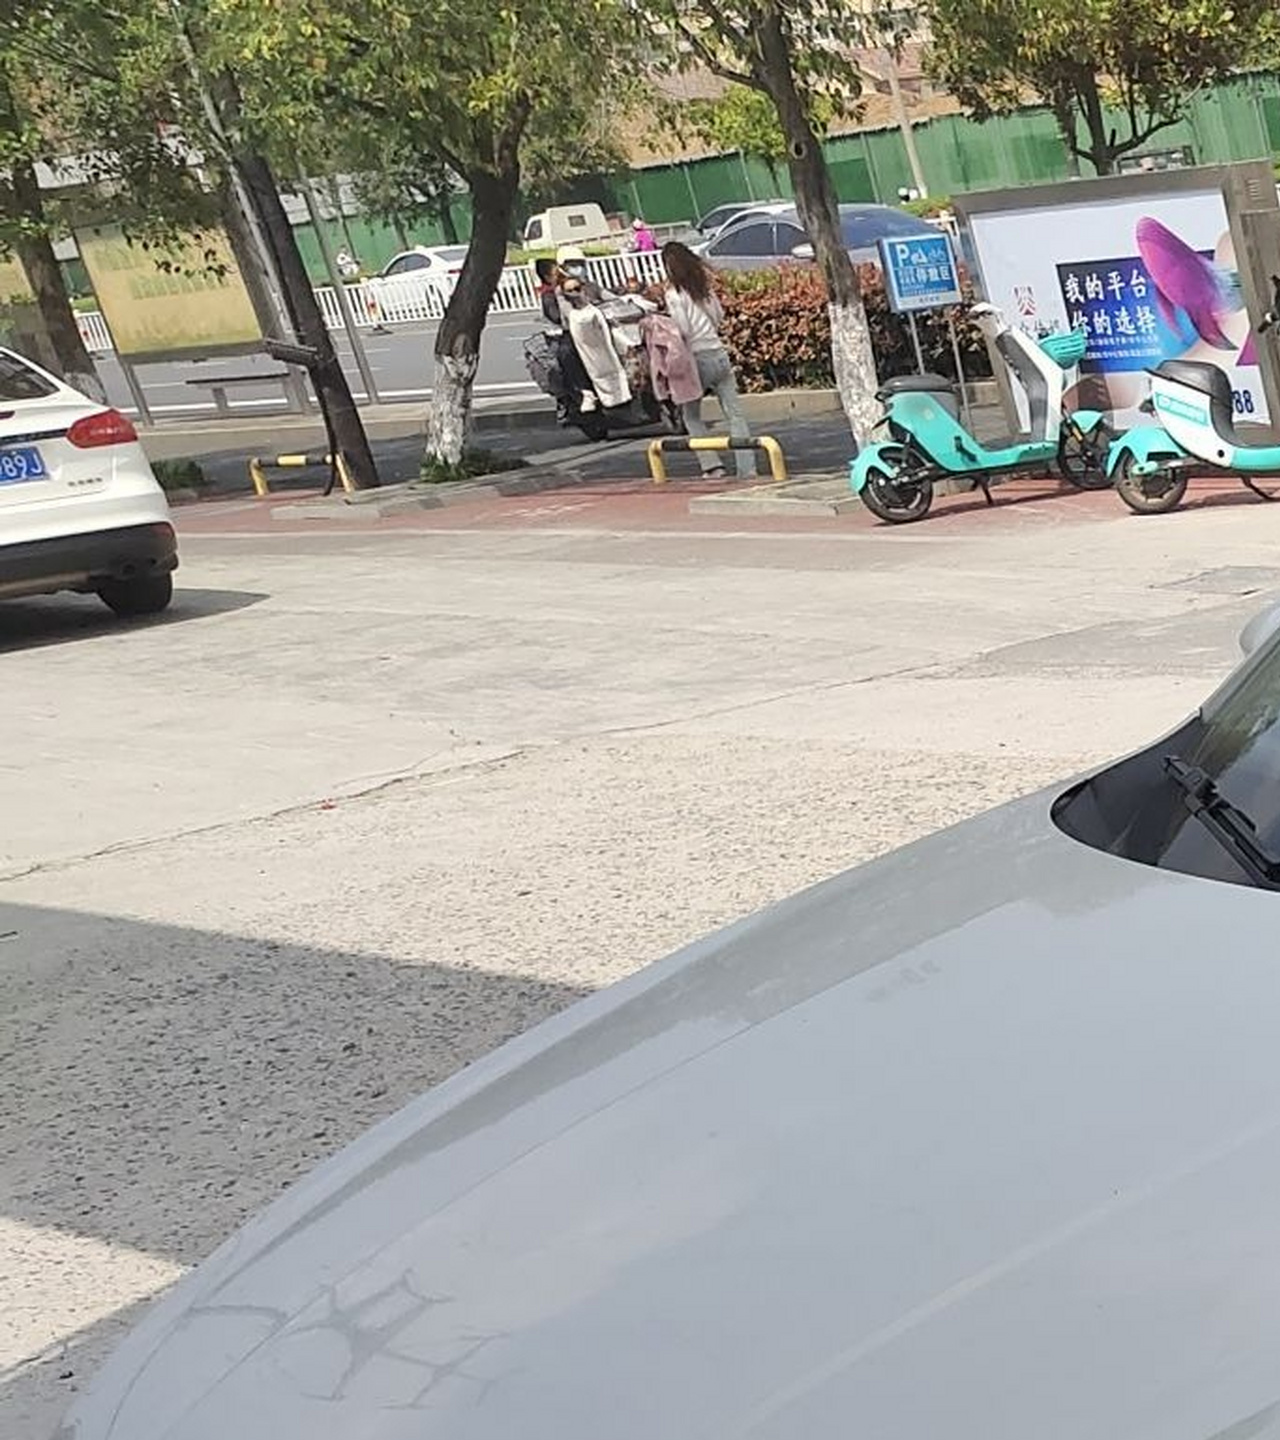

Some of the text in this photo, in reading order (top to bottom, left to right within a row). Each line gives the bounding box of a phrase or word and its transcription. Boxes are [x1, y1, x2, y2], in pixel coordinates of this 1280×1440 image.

[895, 244, 910, 268] P
[1065, 269, 1146, 303] 我的平台
[1072, 305, 1156, 337] 你的选择
[1230, 389, 1255, 413] 88
[0, 453, 42, 478] 89J
